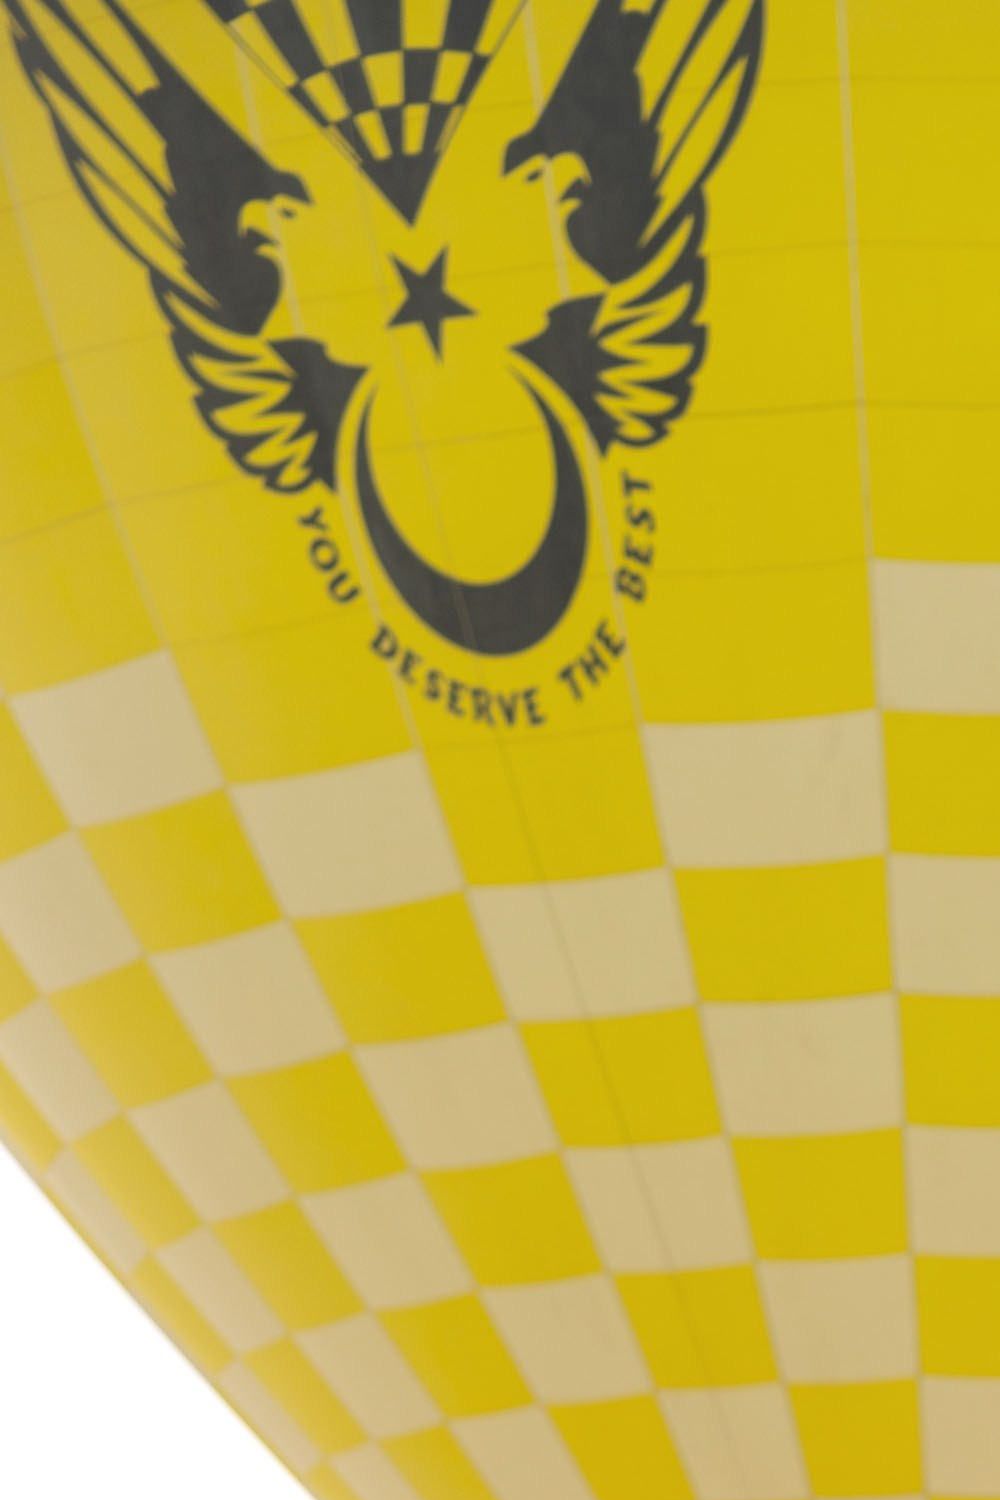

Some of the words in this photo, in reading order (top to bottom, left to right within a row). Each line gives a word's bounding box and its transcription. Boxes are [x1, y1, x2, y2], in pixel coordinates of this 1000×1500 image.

[298, 507, 361, 605] YOU
[369, 623, 546, 728] DESERVE
[557, 618, 627, 702] THE
[614, 469, 656, 603] BEST
